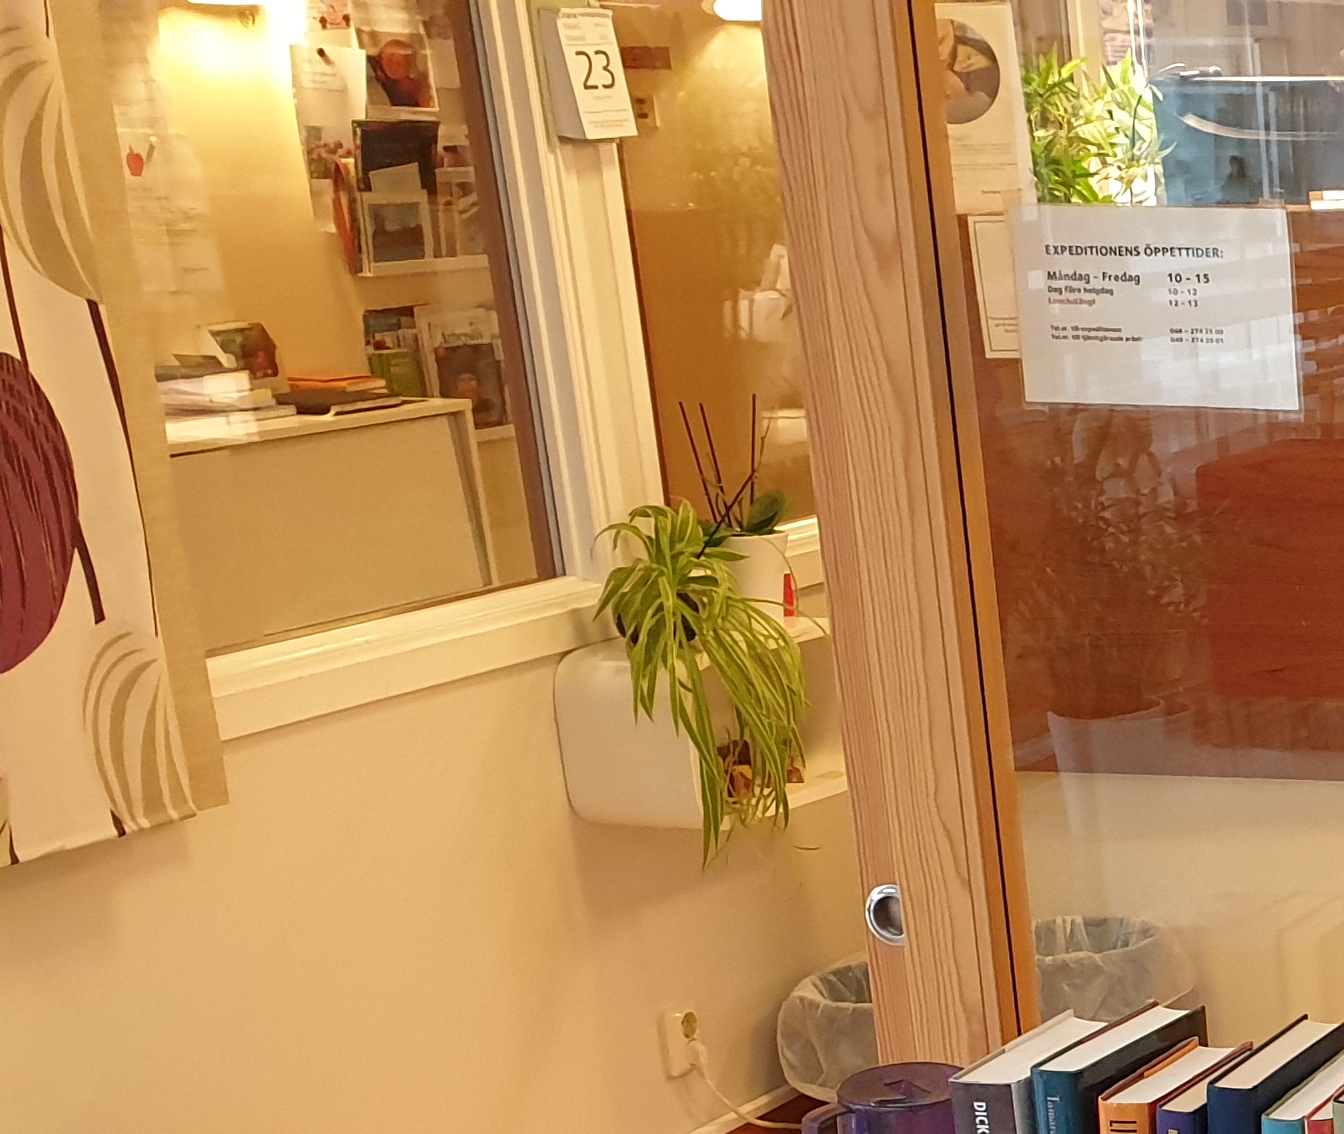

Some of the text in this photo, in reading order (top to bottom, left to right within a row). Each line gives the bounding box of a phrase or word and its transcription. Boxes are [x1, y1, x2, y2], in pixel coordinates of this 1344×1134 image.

[574, 49, 615, 90] 23
[1045, 244, 1141, 257] EXPEDITIONENS
[1046, 270, 1141, 285] Måndag Fredag
[1167, 273, 1210, 284] 10 15
[973, 1101, 989, 1134] DICK
